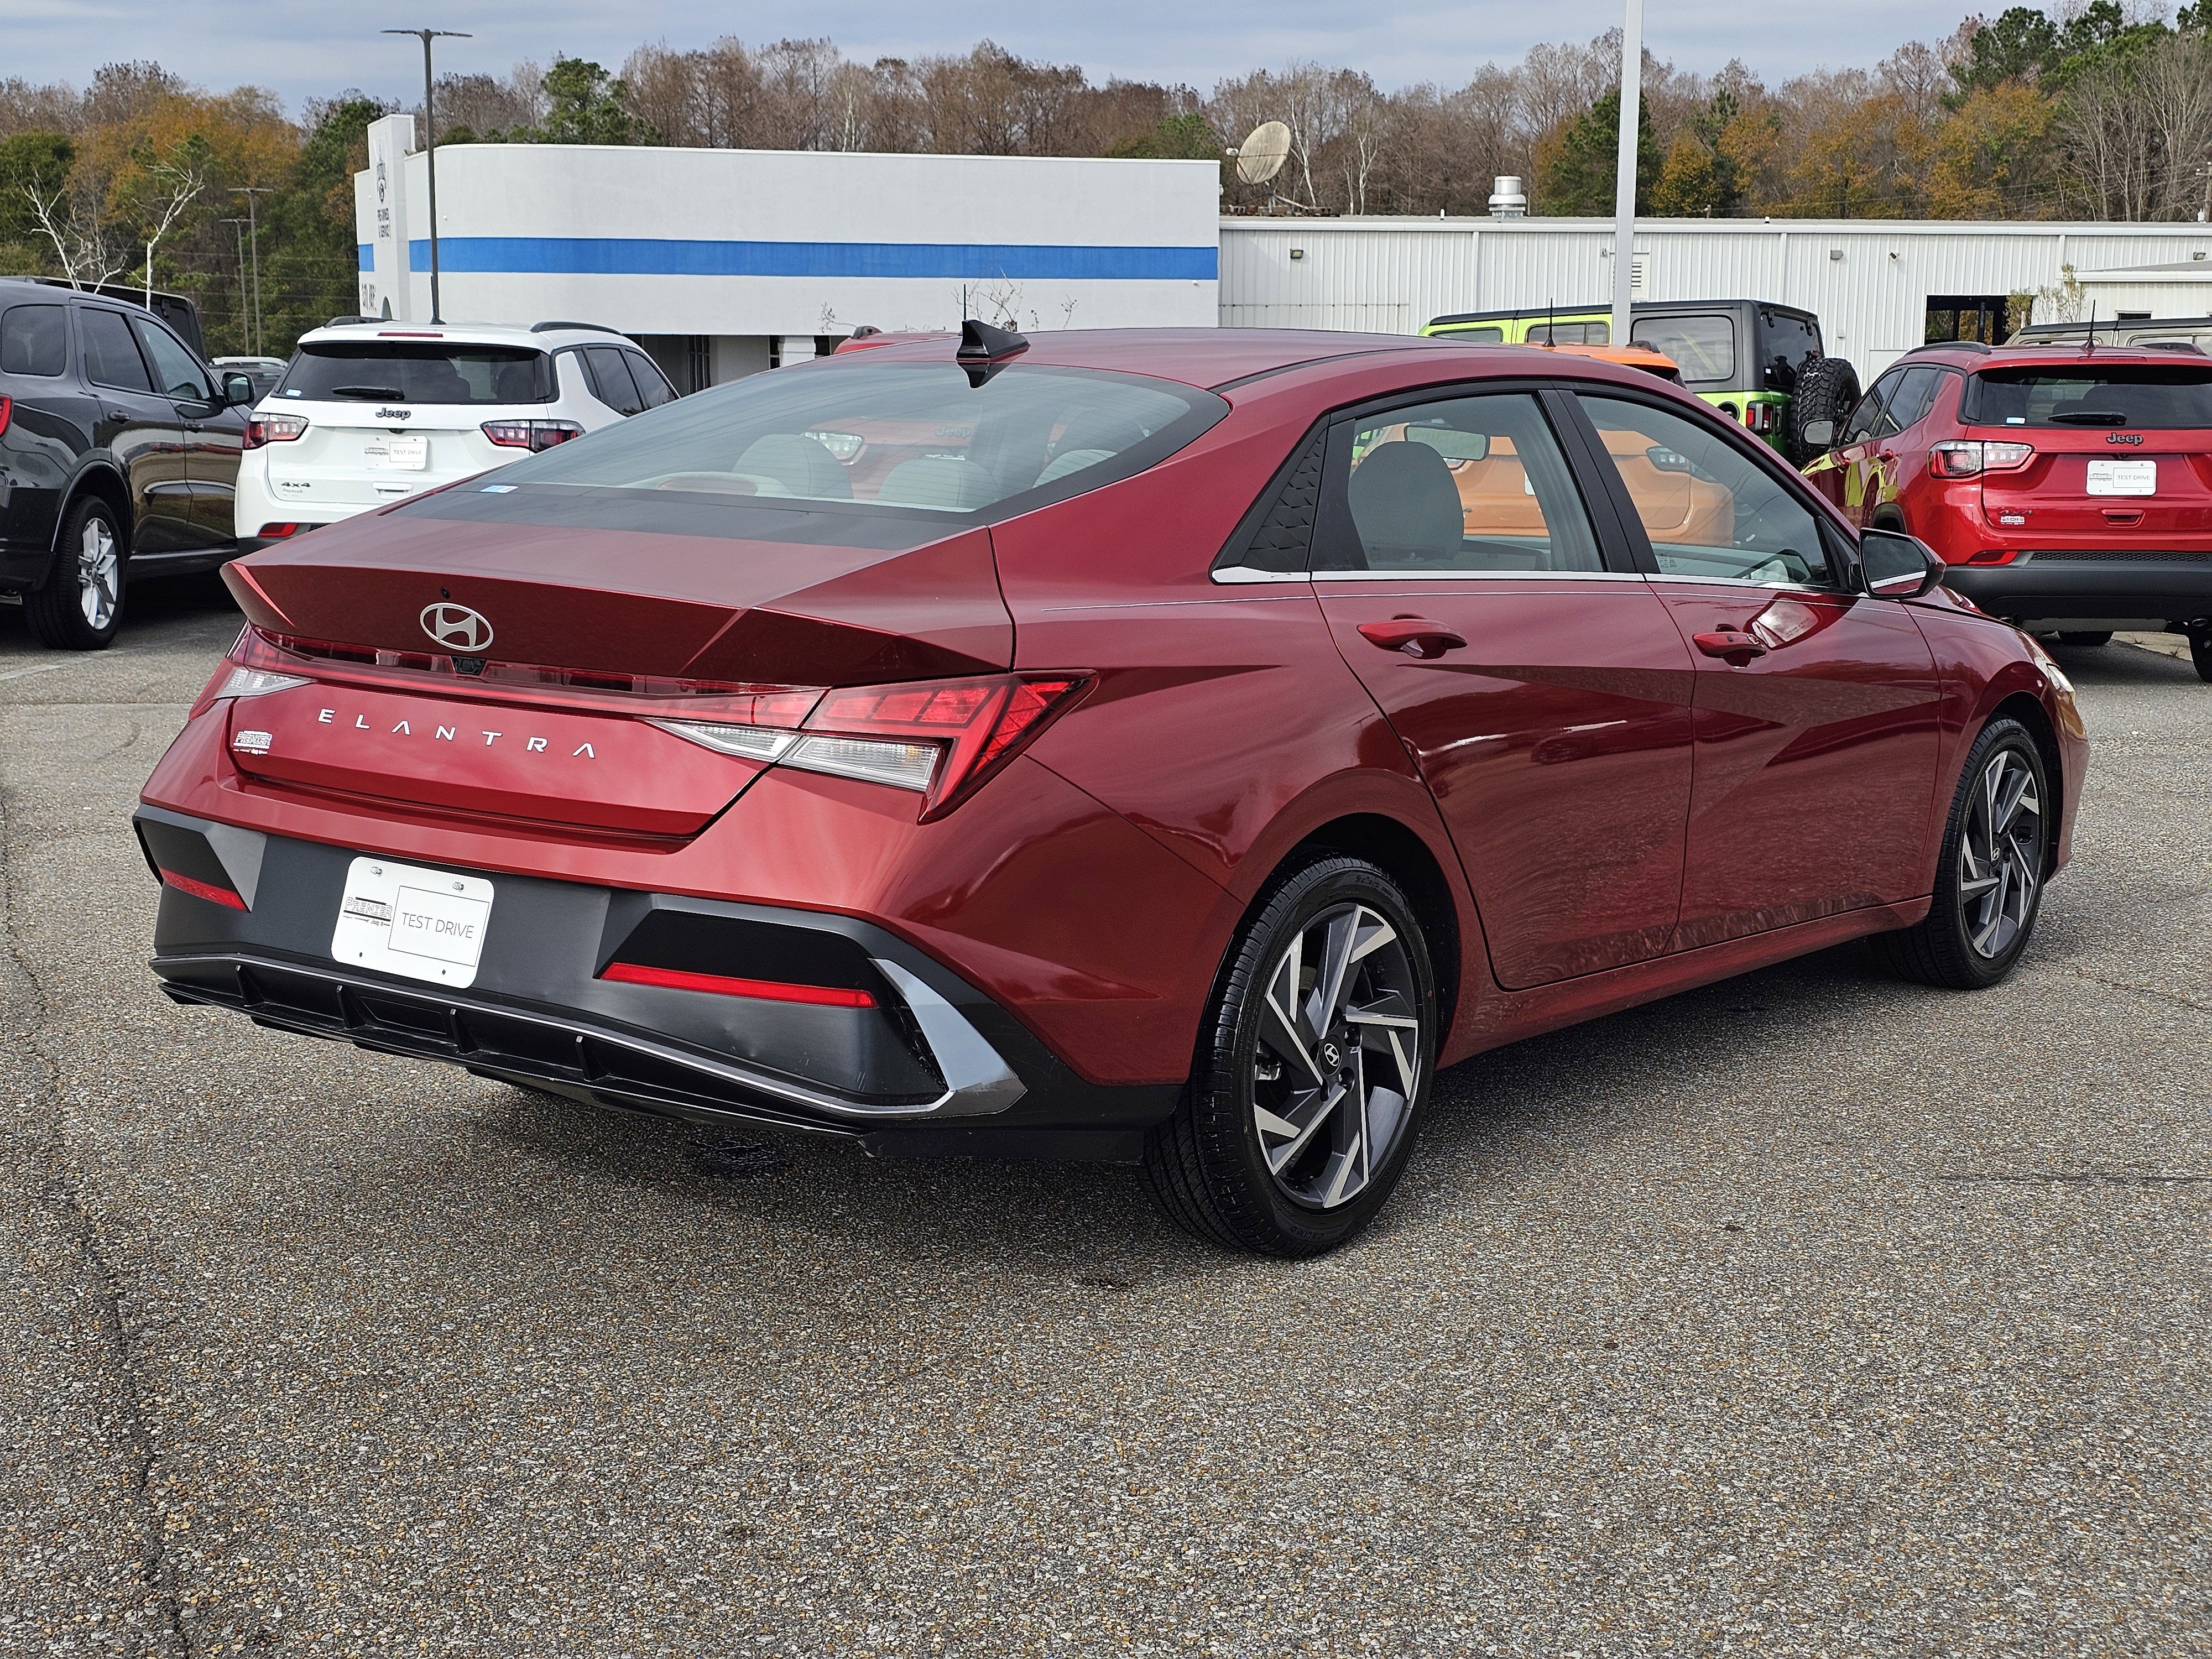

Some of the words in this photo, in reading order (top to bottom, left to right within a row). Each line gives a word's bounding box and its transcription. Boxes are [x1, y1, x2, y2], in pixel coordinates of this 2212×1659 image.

[375, 407, 411, 420] Jeep
[935, 425, 972, 439] Jeep
[2106, 432, 2144, 446] Jeep
[318, 708, 596, 759] ELANTRA
[345, 896, 393, 919] PREMIER
[402, 912, 433, 930] TEST
[435, 919, 474, 939] DRIVE
